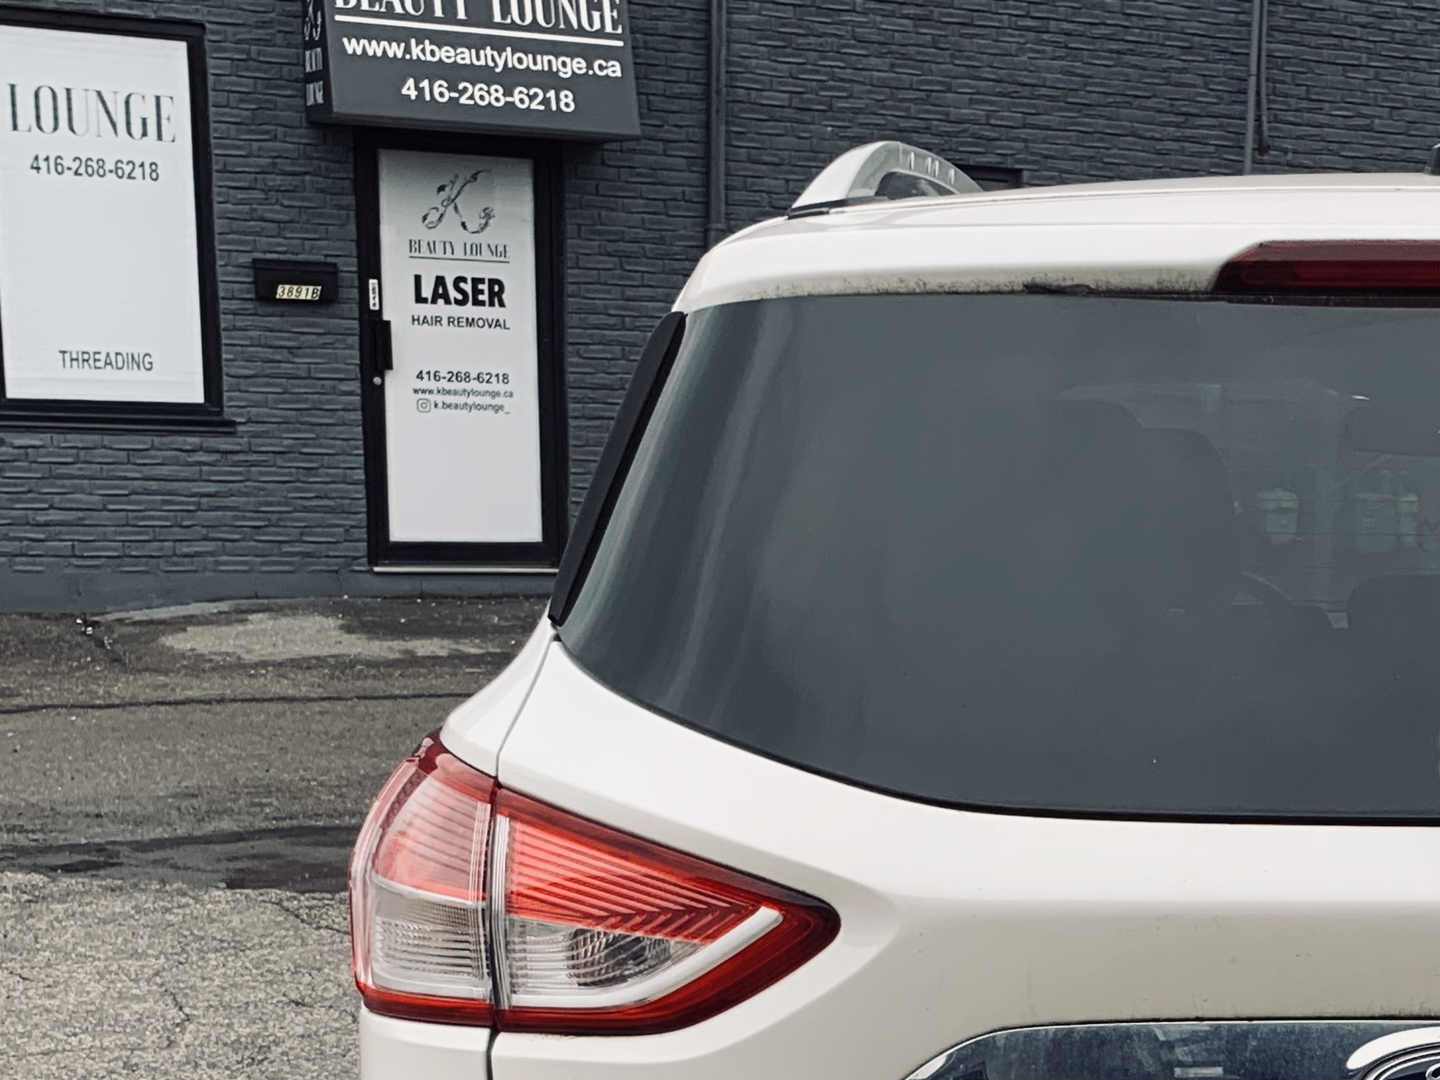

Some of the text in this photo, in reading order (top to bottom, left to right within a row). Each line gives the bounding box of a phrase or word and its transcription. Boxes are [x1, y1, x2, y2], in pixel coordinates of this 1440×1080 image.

[342, 35, 622, 79] www.kbeautylounge.ca
[401, 78, 575, 113] 416-268-6218
[7, 83, 176, 143] LOUNGE
[30, 154, 160, 182] 416-268-6218
[408, 239, 509, 259] BEAUTY LOUNGE
[278, 286, 320, 299] 3891B
[413, 274, 506, 308] LASER
[411, 314, 511, 330] HAIR REMOVAL
[59, 350, 154, 372] THREADING
[416, 370, 510, 385] 416-268-6218
[412, 387, 514, 399] www.kbeautylounge.ca
